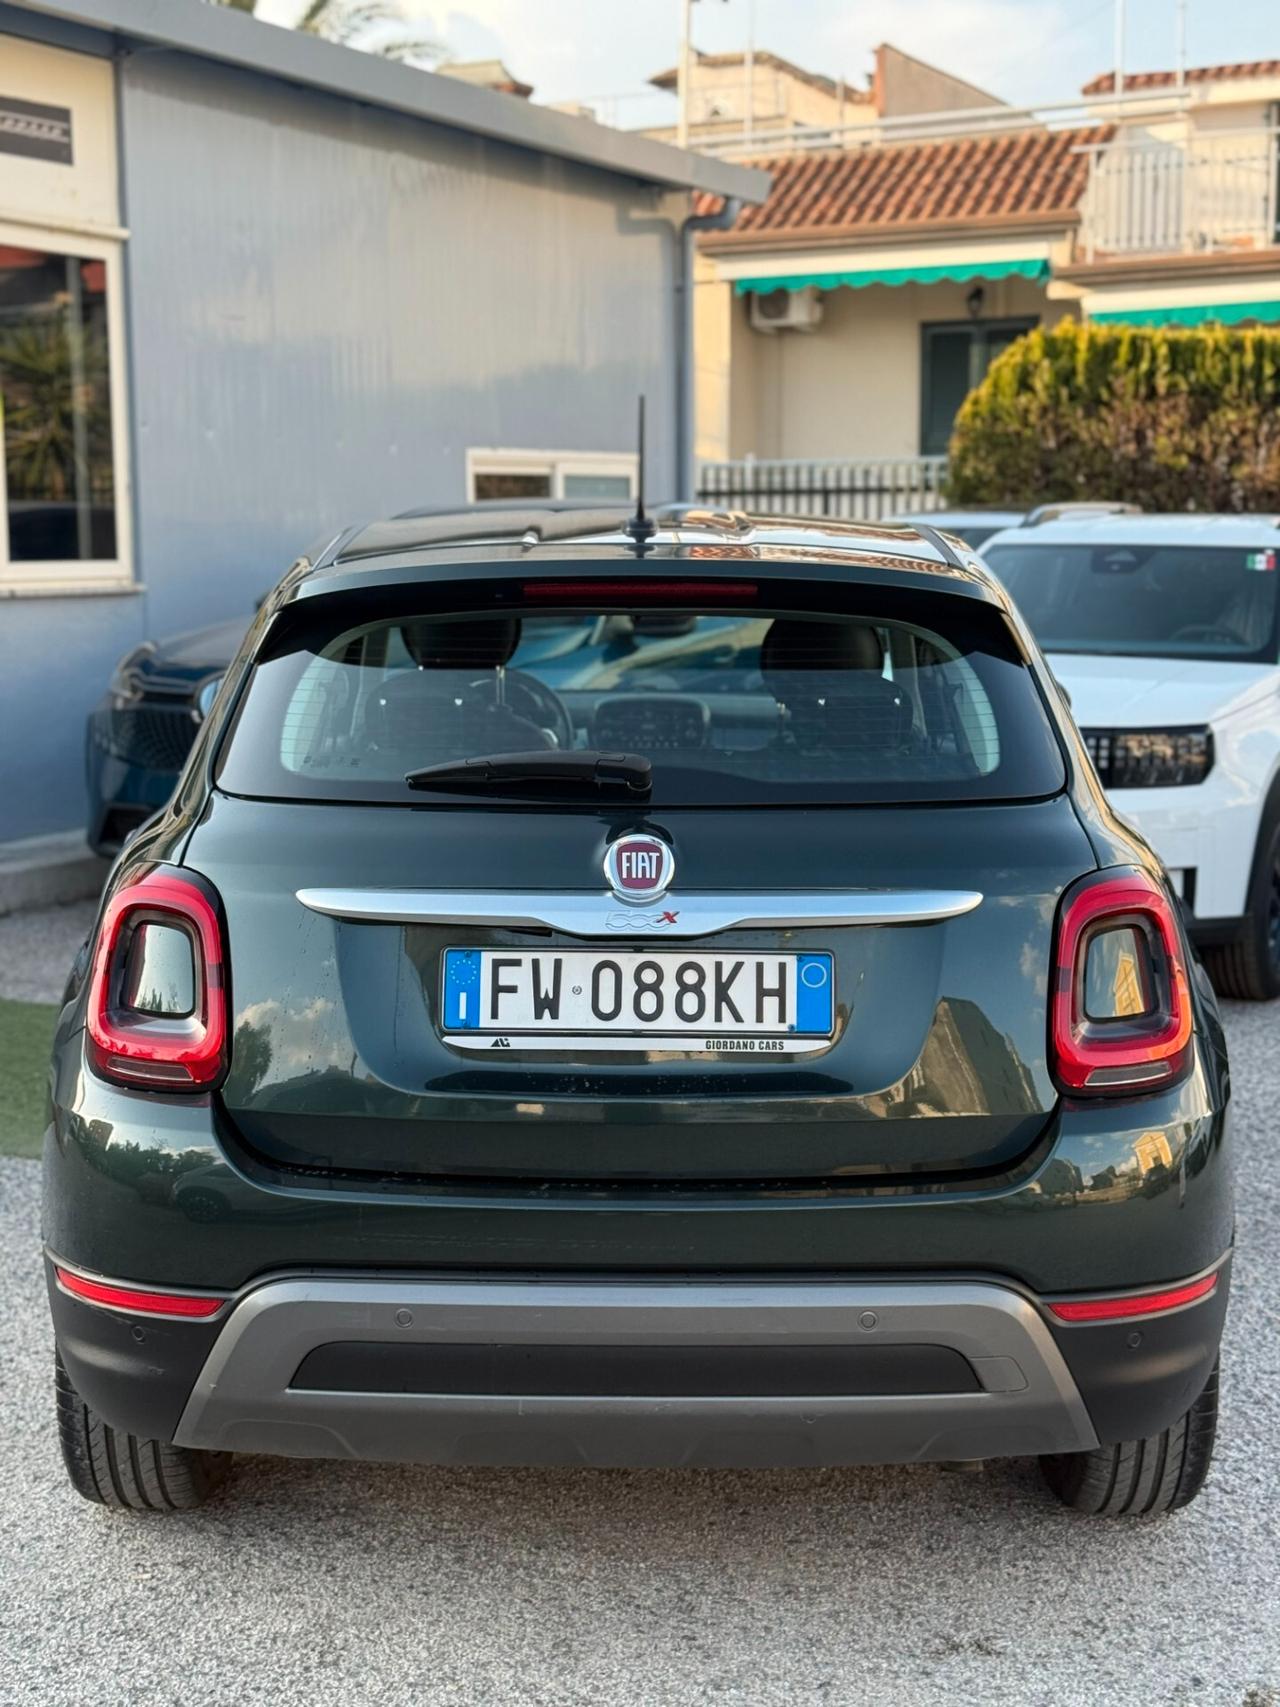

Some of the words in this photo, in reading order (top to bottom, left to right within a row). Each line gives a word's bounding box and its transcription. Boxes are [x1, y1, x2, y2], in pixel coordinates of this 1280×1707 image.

[621, 852, 660, 879] FIAT
[490, 958, 563, 1020] FW
[591, 960, 787, 1024] 088KH
[705, 1040, 755, 1050] GIORDANO
[758, 1041, 785, 1050] CARS
